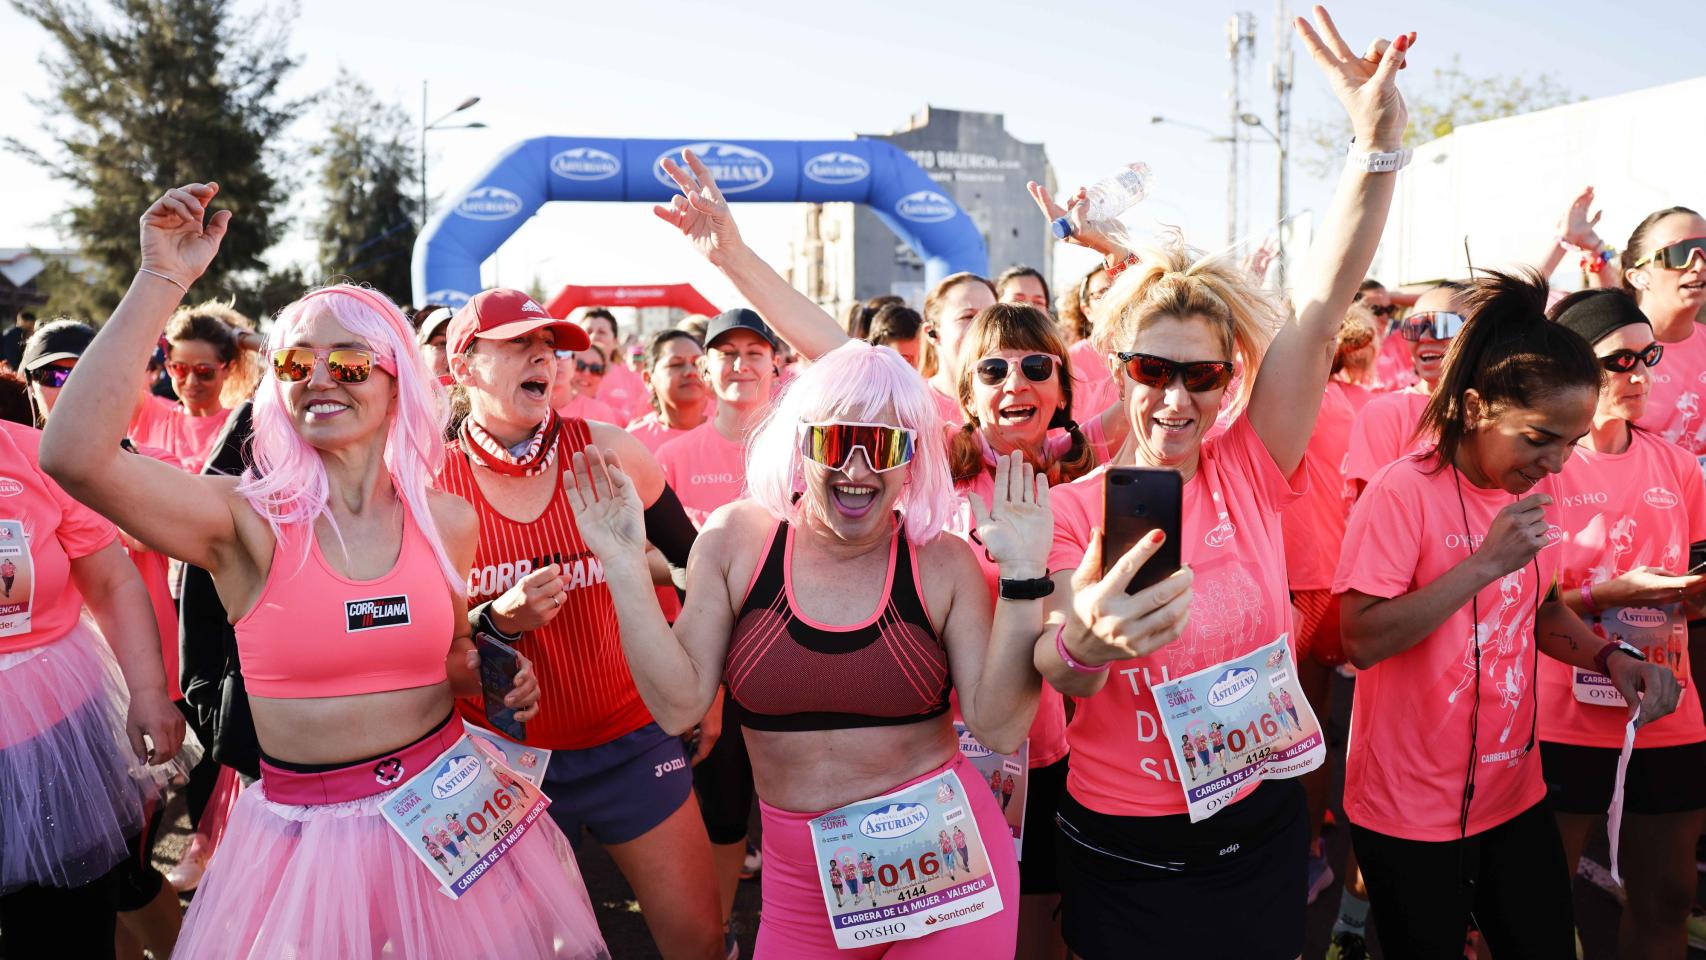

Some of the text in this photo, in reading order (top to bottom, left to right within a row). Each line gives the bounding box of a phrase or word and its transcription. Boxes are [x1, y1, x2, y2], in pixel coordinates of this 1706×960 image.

[691, 472, 733, 485] OYSHO
[1445, 534, 1485, 548] OYSH
[349, 601, 406, 618] CORRELIANA
[1212, 674, 1255, 704] ASTURIANA
[1589, 688, 1623, 700] OYSH
[1168, 693, 1196, 708] SUMA
[1226, 713, 1278, 753] 016
[1245, 746, 1271, 765] 4142
[1270, 758, 1313, 774] Santander
[1195, 777, 1232, 798] CARRERA
[1233, 772, 1244, 783] DE
[1245, 766, 1254, 778] LA
[1285, 738, 1316, 758] VALENCIA
[397, 796, 422, 817] SUMA
[466, 788, 513, 835] 016
[492, 819, 514, 842] 4139
[865, 810, 926, 834] ASTURIANA
[458, 859, 491, 890] CARRERA
[489, 850, 501, 863] DE
[499, 842, 508, 854] LA
[507, 824, 526, 845] MUJER
[525, 800, 546, 825] VALENCIA
[878, 852, 940, 887] 016
[841, 910, 882, 926] CARRERA
[884, 906, 896, 917] DE
[897, 904, 909, 914] LA
[911, 896, 940, 912] MUJER
[946, 880, 987, 899] VALENCIA
[897, 884, 927, 902] 4144
[938, 901, 985, 922] Santander
[854, 922, 906, 941] OYSHO
